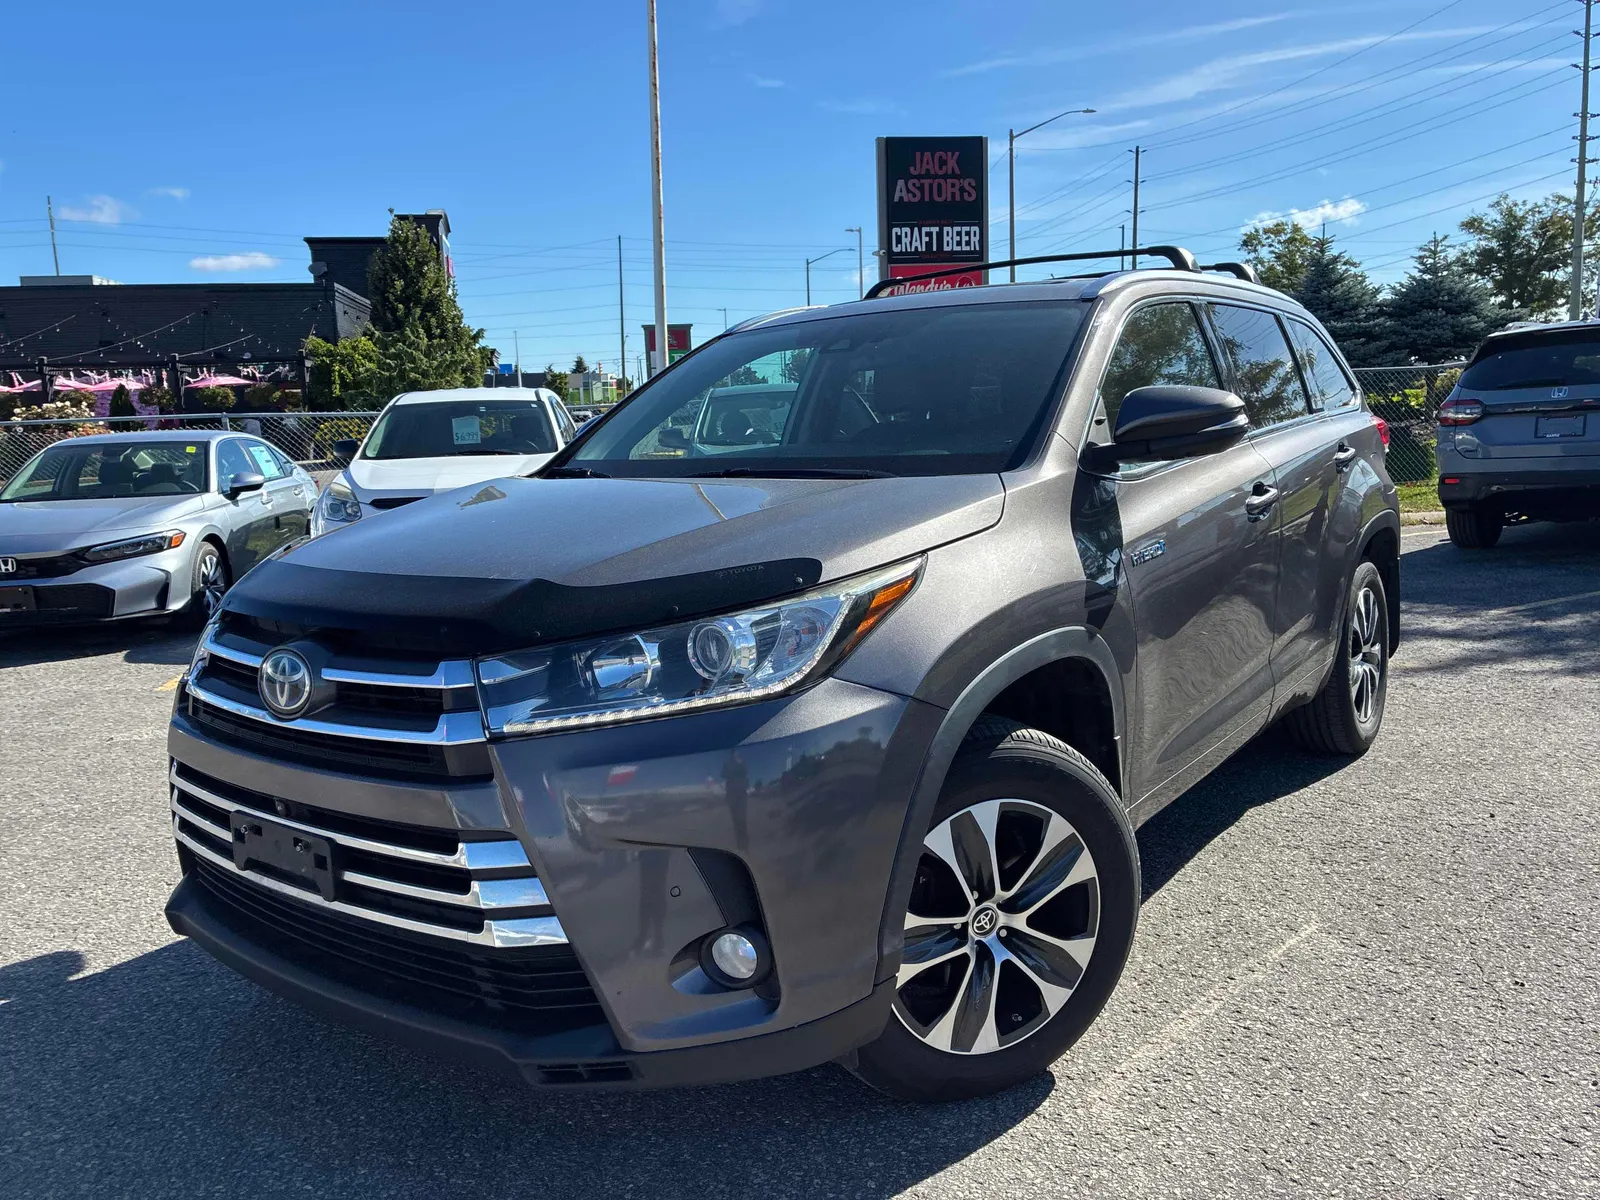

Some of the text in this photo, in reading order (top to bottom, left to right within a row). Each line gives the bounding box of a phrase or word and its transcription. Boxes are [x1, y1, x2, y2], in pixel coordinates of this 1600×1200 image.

[909, 151, 961, 175] JACK
[893, 178, 977, 203] ASTOR'S
[891, 225, 980, 252] CRAFT BEER
[728, 564, 765, 574] TOYOTA
